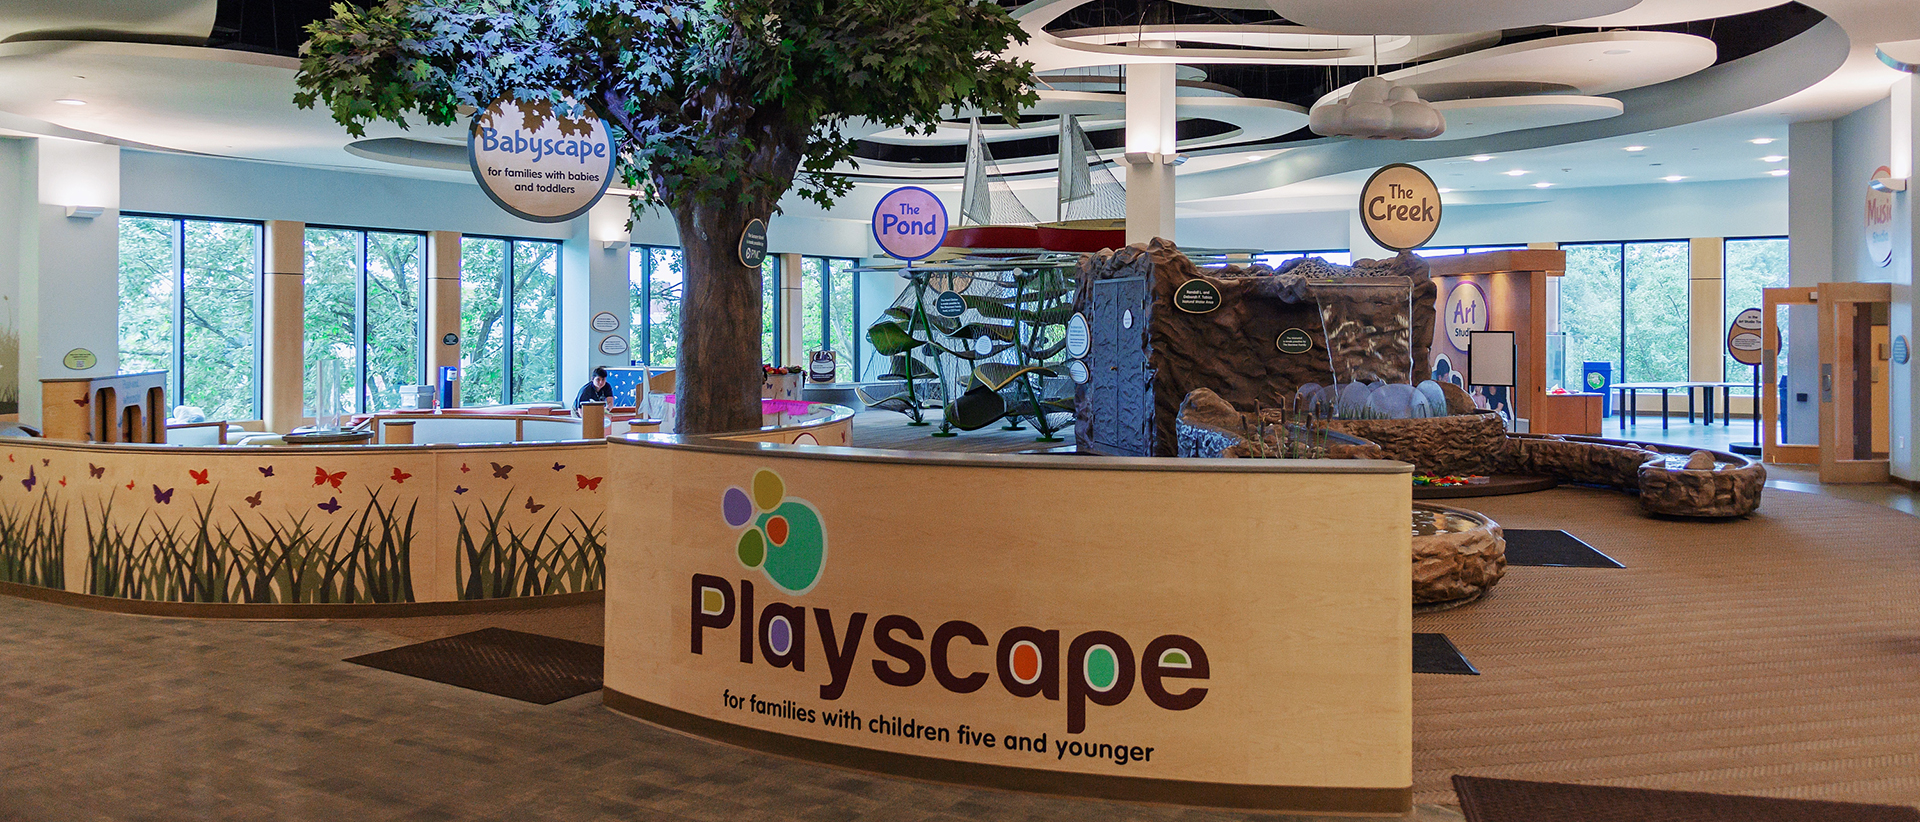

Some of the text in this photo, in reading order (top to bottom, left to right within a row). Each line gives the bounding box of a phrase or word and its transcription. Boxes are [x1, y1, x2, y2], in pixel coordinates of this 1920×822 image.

[482, 127, 606, 164] Babyscape
[488, 167, 600, 182] for families with babies
[514, 183, 576, 194] and toddlers
[1388, 183, 1414, 199] The
[899, 203, 920, 215] The
[1368, 195, 1434, 222] Creek
[882, 213, 936, 236] Pond
[1453, 299, 1476, 324] Art
[690, 572, 1210, 735] Playscape
[722, 690, 1156, 766] for families with children five and younger
